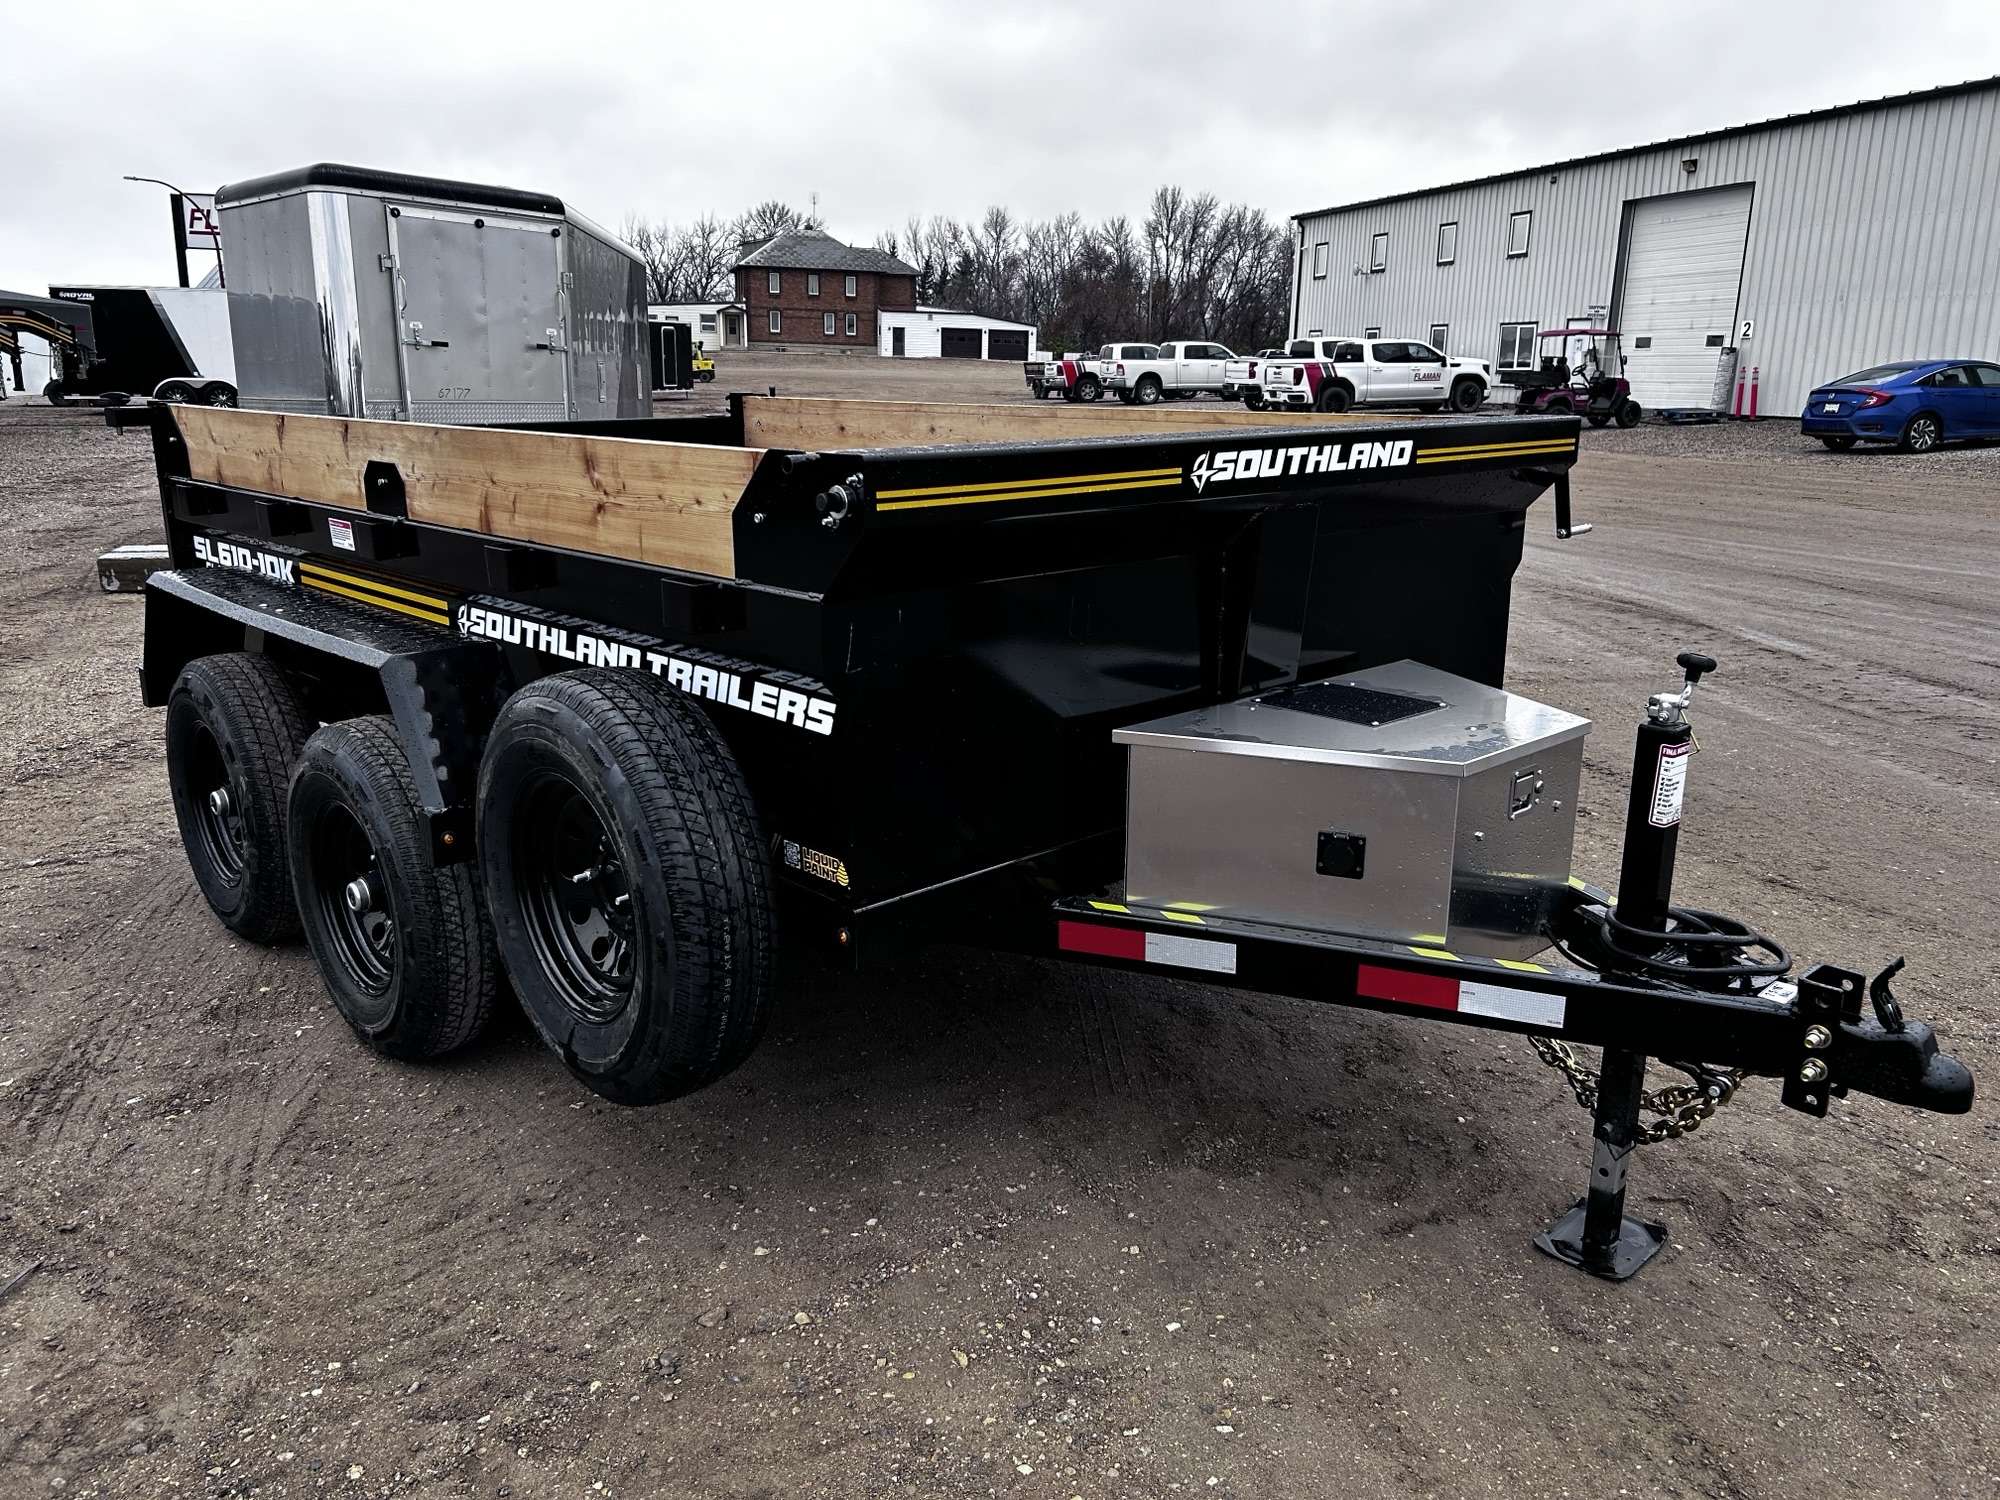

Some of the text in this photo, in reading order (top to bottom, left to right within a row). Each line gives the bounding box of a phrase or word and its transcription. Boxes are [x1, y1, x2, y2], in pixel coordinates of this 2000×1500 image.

[1742, 321, 1751, 337] 2
[1414, 372, 1441, 380] FLAMAN
[1210, 440, 1414, 482] SOUTHLAND
[193, 535, 295, 584] SL610-10K
[469, 607, 836, 736] SOUTHLAND TRAILERS
[802, 846, 840, 872] LIQUID
[803, 859, 838, 883] PAINT
